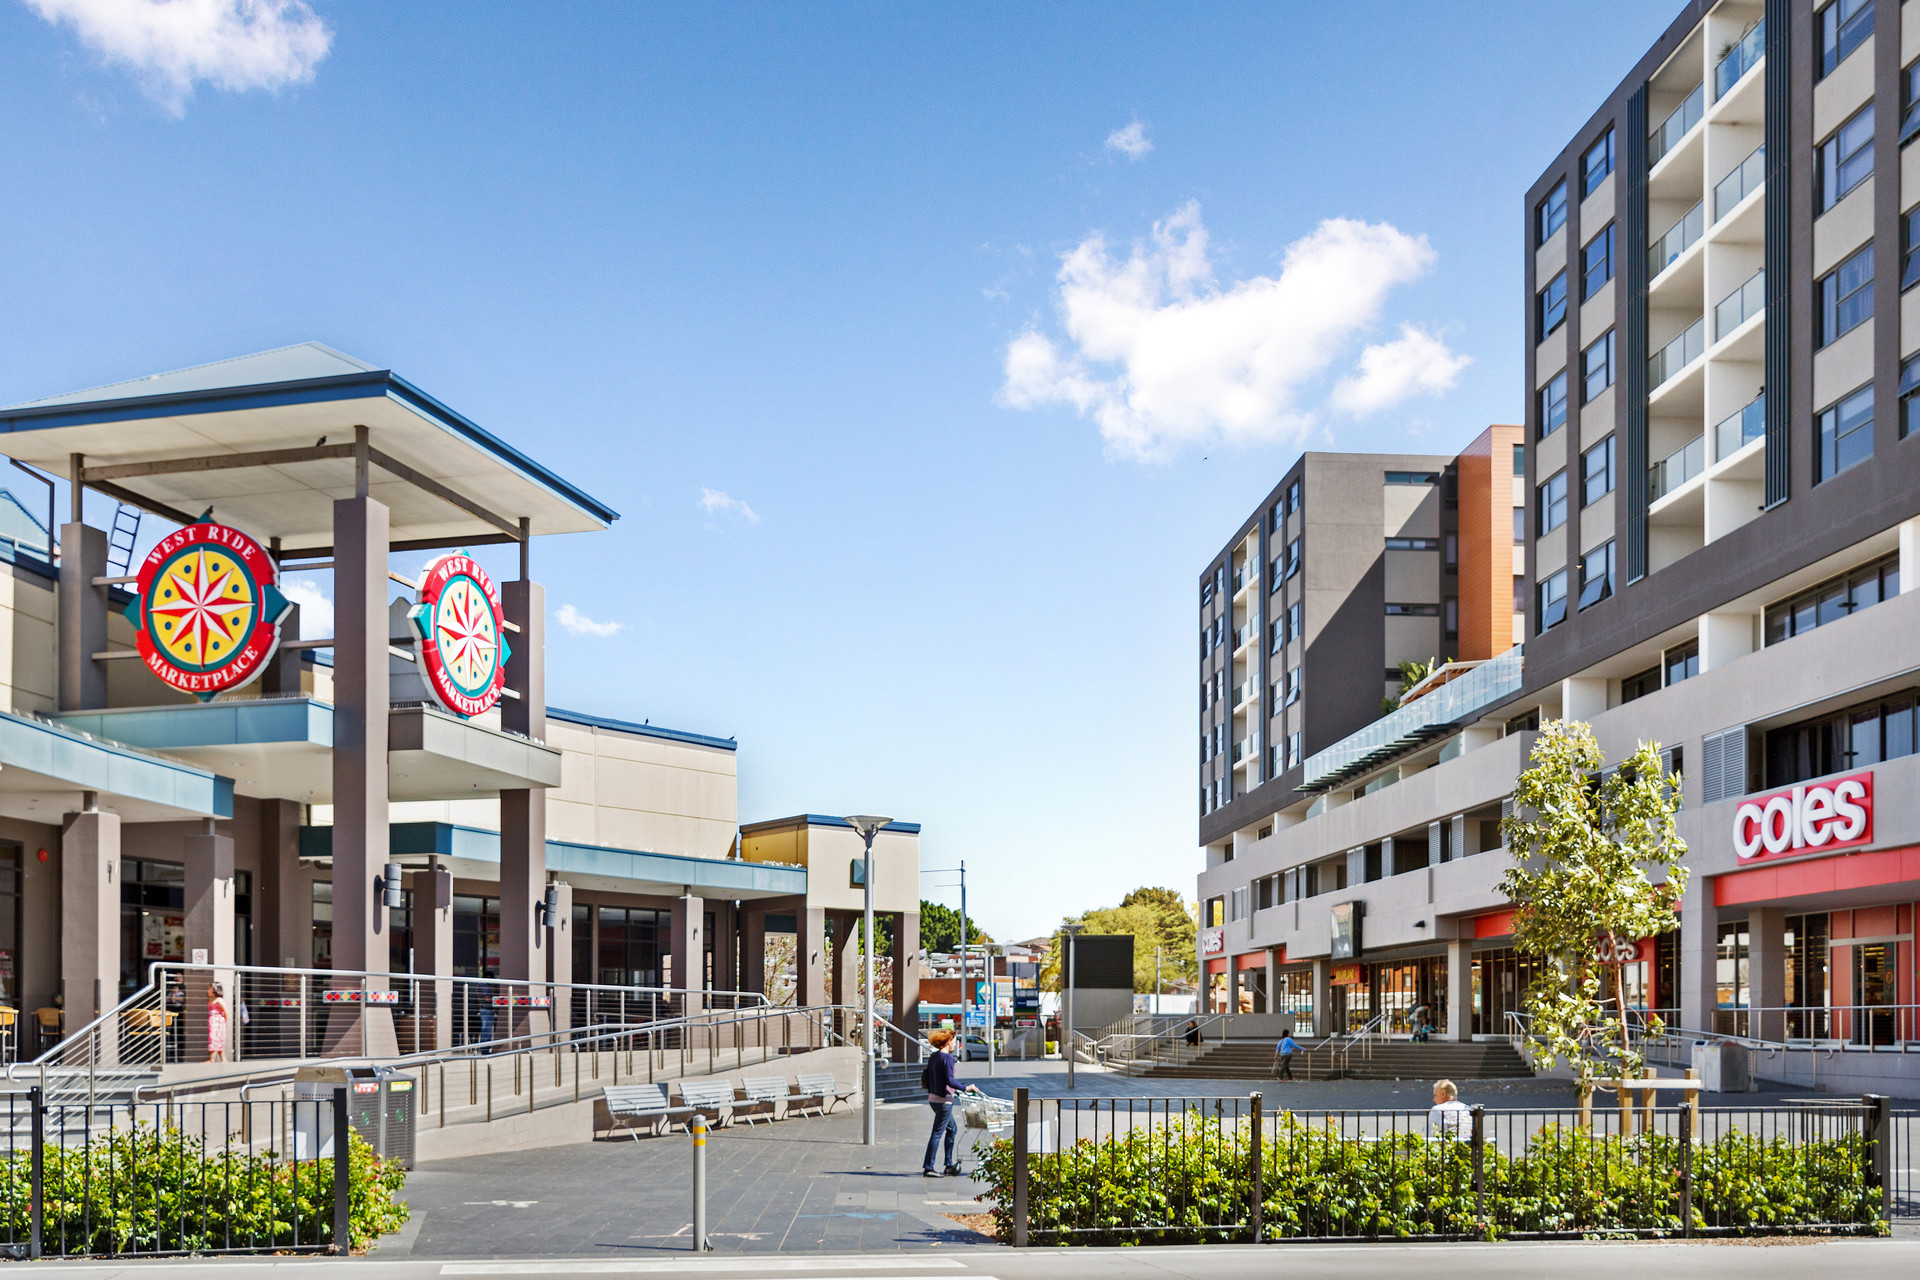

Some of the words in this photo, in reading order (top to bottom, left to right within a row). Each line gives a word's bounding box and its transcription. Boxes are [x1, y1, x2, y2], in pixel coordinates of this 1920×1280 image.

[147, 527, 197, 565] WEST
[207, 525, 256, 560] RYDE
[438, 556, 469, 582] WEST
[472, 562, 500, 608] RYDE
[147, 645, 259, 689] MARKETPLACE
[436, 666, 501, 714] MARKETPLACE
[1732, 780, 1867, 859] coles
